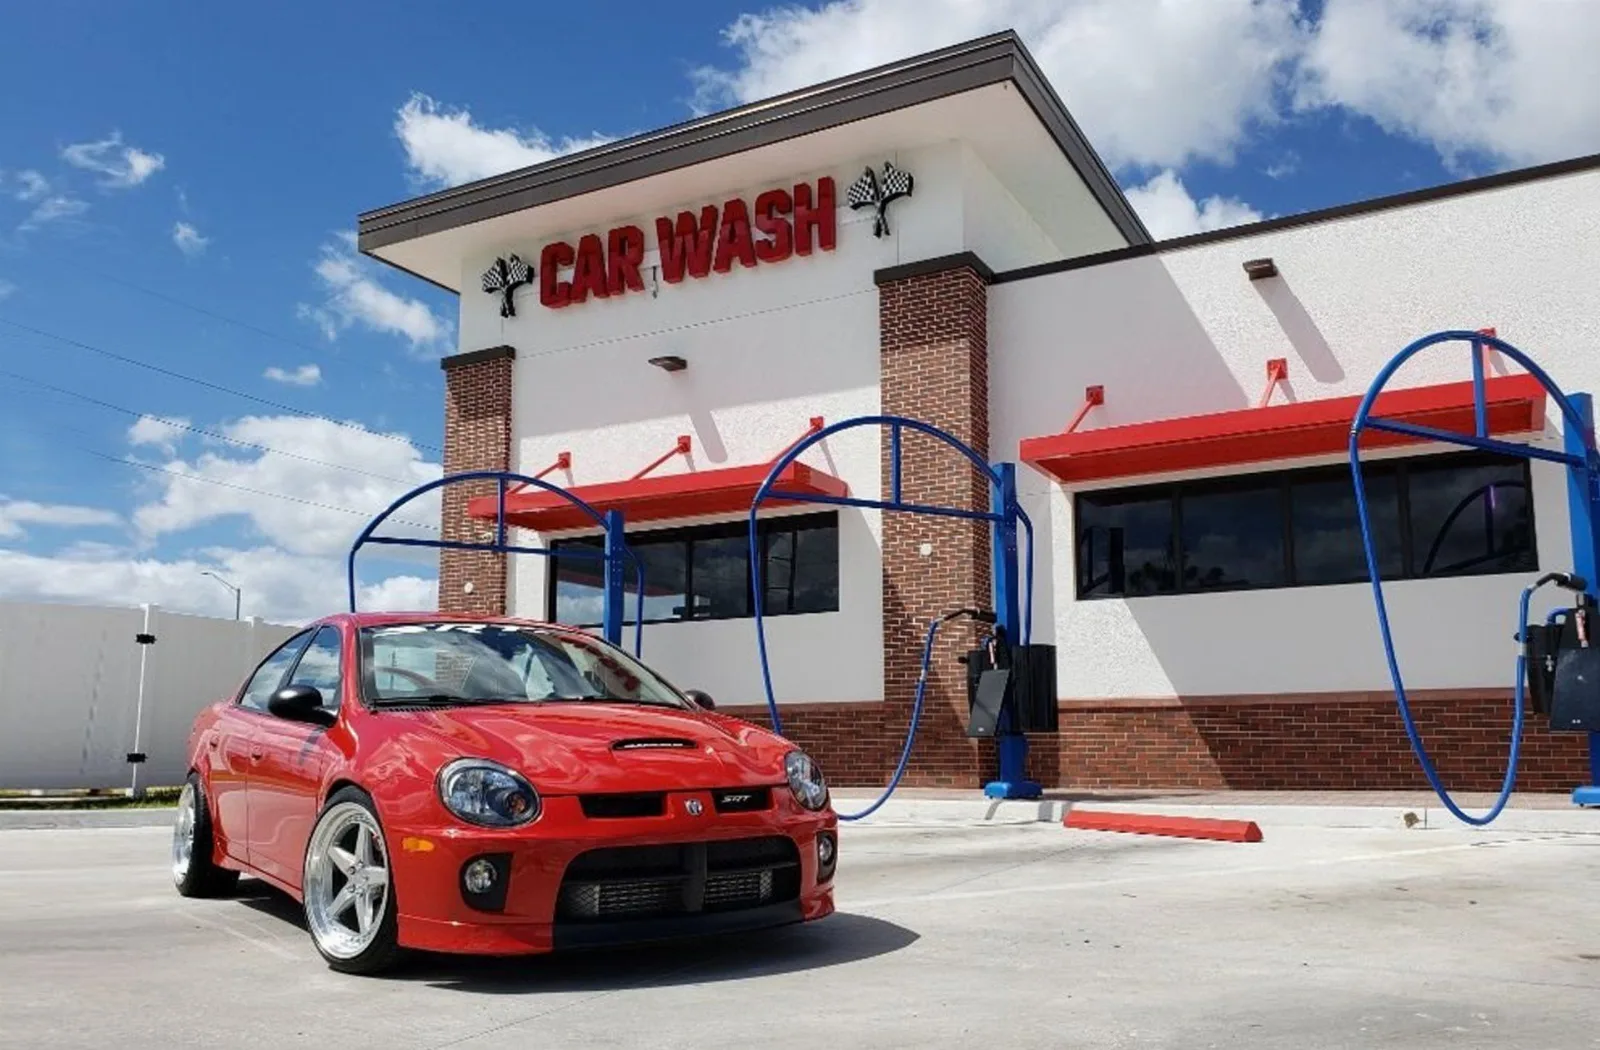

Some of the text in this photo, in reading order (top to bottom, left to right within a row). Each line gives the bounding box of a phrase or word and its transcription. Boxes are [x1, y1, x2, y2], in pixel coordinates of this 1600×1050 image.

[540, 176, 837, 309] CAR WASH
[721, 794, 752, 804] SRT
